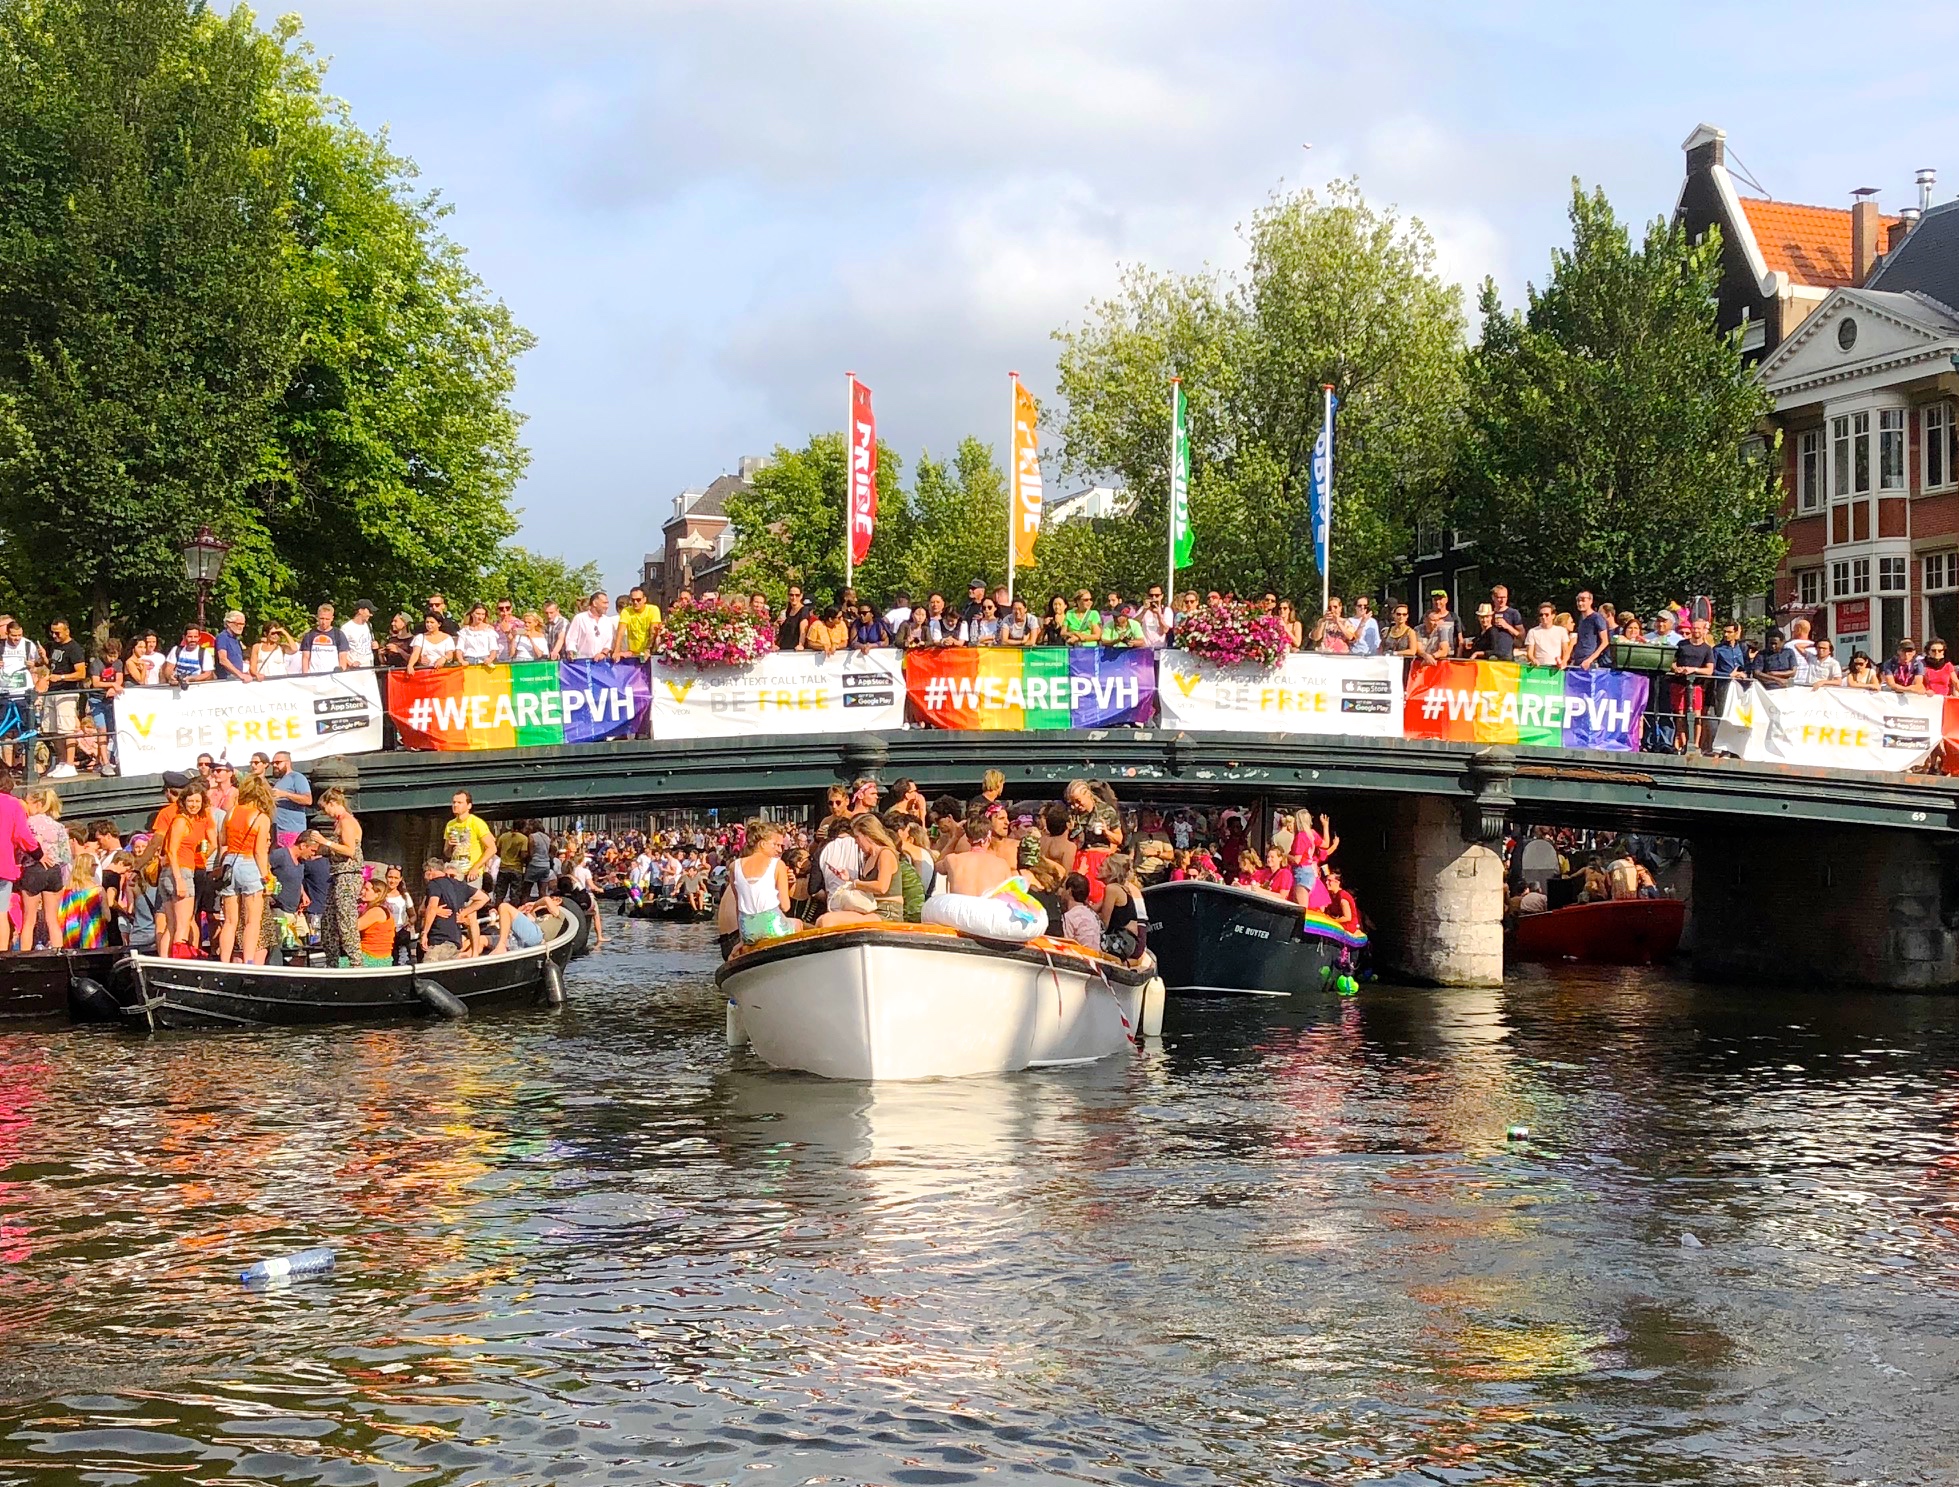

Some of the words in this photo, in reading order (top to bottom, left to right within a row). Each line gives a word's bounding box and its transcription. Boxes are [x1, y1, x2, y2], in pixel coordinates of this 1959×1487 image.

[743, 676, 768, 686] TEXT
[771, 676, 798, 685] CALL
[800, 674, 828, 684] TALK
[858, 678, 872, 686] App
[924, 675, 1139, 710] #WEAREPVH
[1357, 685, 1370, 693] App
[1370, 685, 1389, 693] Store
[330, 703, 345, 711] App
[345, 702, 364, 710] Store
[710, 691, 746, 712] BE
[758, 688, 829, 711] FREE
[857, 697, 879, 706] Google
[879, 697, 891, 705] Play
[1260, 687, 1328, 712] FREE
[181, 708, 204, 717] HAT
[207, 706, 234, 718] TEXT
[237, 704, 265, 714] CALL
[268, 702, 298, 711] TALK
[408, 686, 636, 732] #WEAREPVH
[1355, 703, 1377, 712] Google
[1377, 704, 1389, 712] Play
[1421, 687, 1632, 733] #WEAREPVH
[176, 725, 213, 748] BE
[225, 716, 302, 744] FREE
[332, 722, 354, 731] Google
[1801, 723, 1870, 747] FREE
[1911, 811, 1926, 822] 69
[1234, 924, 1244, 934] DE
[1245, 927, 1270, 939] RUYTER
